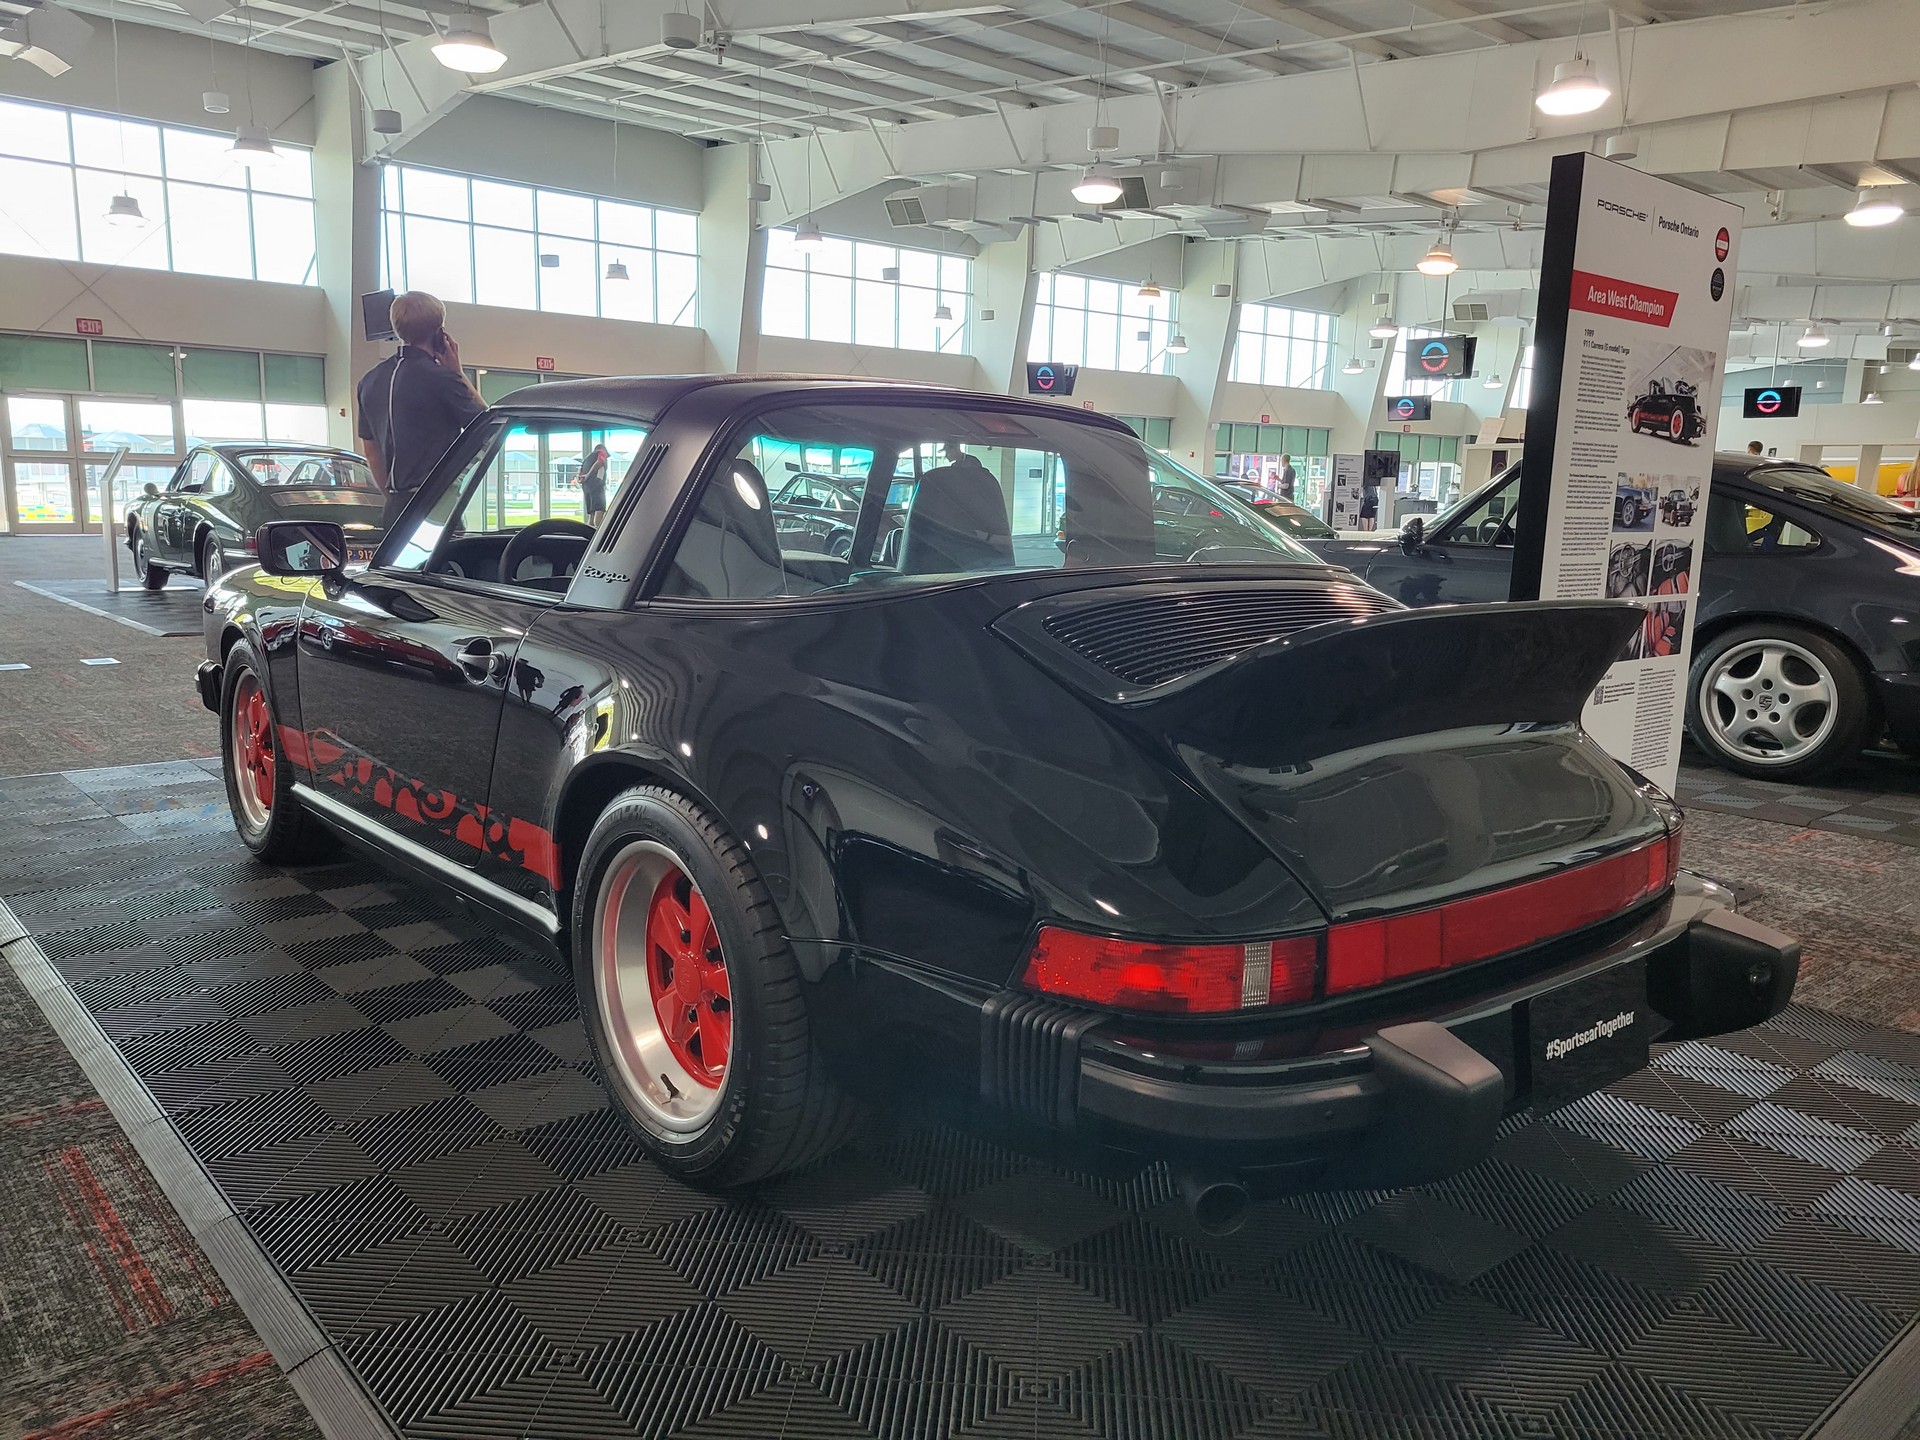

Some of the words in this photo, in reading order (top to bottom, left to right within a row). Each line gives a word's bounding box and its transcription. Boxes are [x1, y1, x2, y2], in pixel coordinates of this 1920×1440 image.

[1597, 199, 1647, 222] PORSCHE
[1658, 216, 1680, 233] Porsche
[1680, 222, 1700, 238] Ontario
[1587, 285, 1607, 304] Area
[1607, 289, 1628, 307] West
[1628, 294, 1665, 317] Champion
[81, 320, 99, 333] EXIT
[358, 550, 374, 560] 912
[1546, 1011, 1634, 1060] #SportscarTogether
